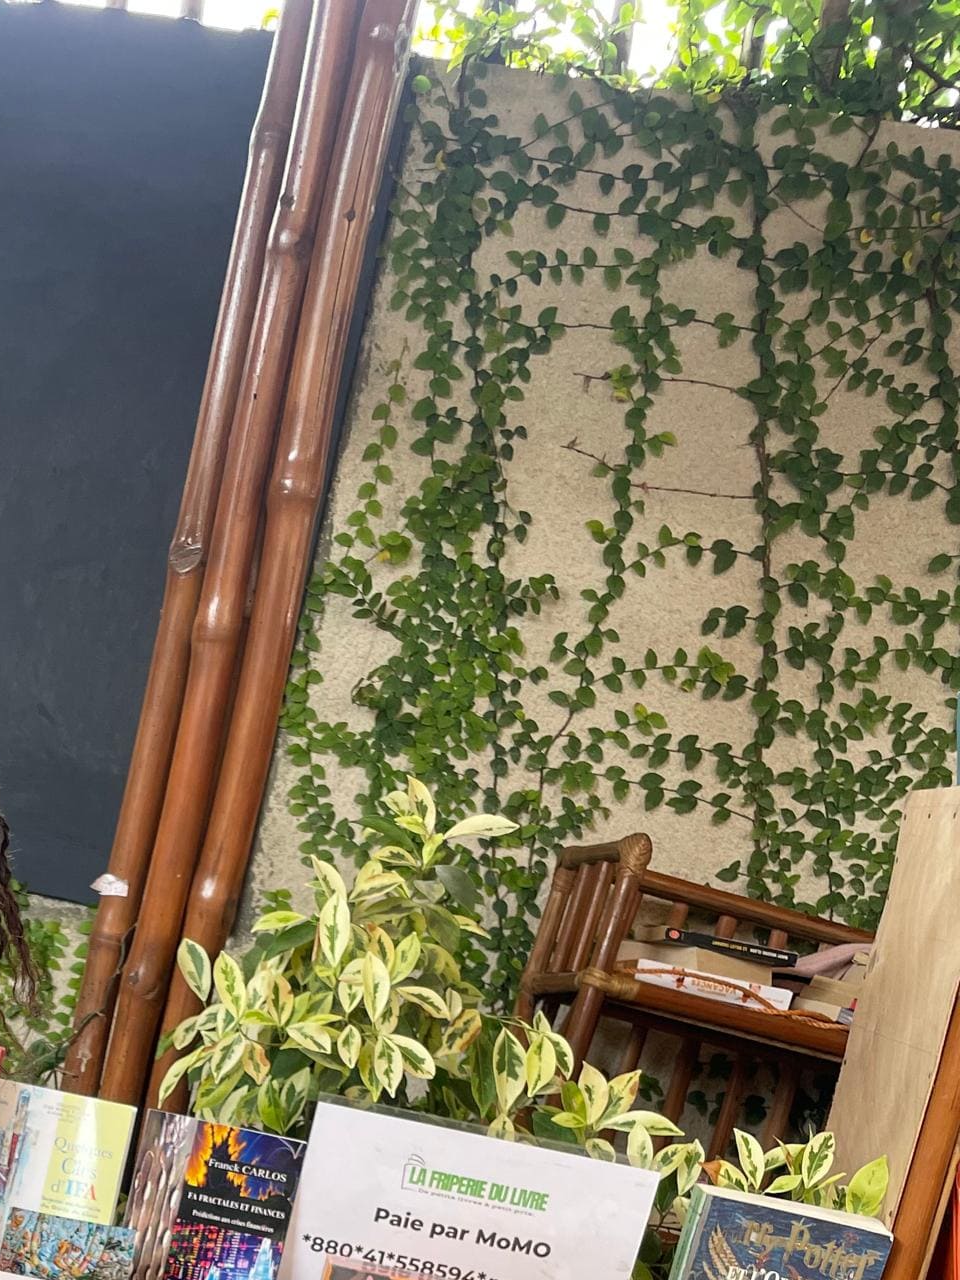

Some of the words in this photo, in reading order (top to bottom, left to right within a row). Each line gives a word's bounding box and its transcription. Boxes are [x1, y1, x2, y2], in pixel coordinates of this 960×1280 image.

[208, 1158, 241, 1173] Franck
[241, 1164, 288, 1183] CARLOS
[408, 1166, 427, 1187] LA
[428, 1170, 488, 1200] FRIPERIE
[488, 1182, 510, 1203] DU
[510, 1187, 550, 1211] LIVRE
[187, 1191, 198, 1201] FA
[198, 1193, 240, 1211] FRACTALES
[239, 1201, 250, 1212] ET
[250, 1204, 286, 1219] FINANCES
[373, 1206, 424, 1232] Paie
[429, 1221, 470, 1241] par
[474, 1228, 552, 1258] MoMO
